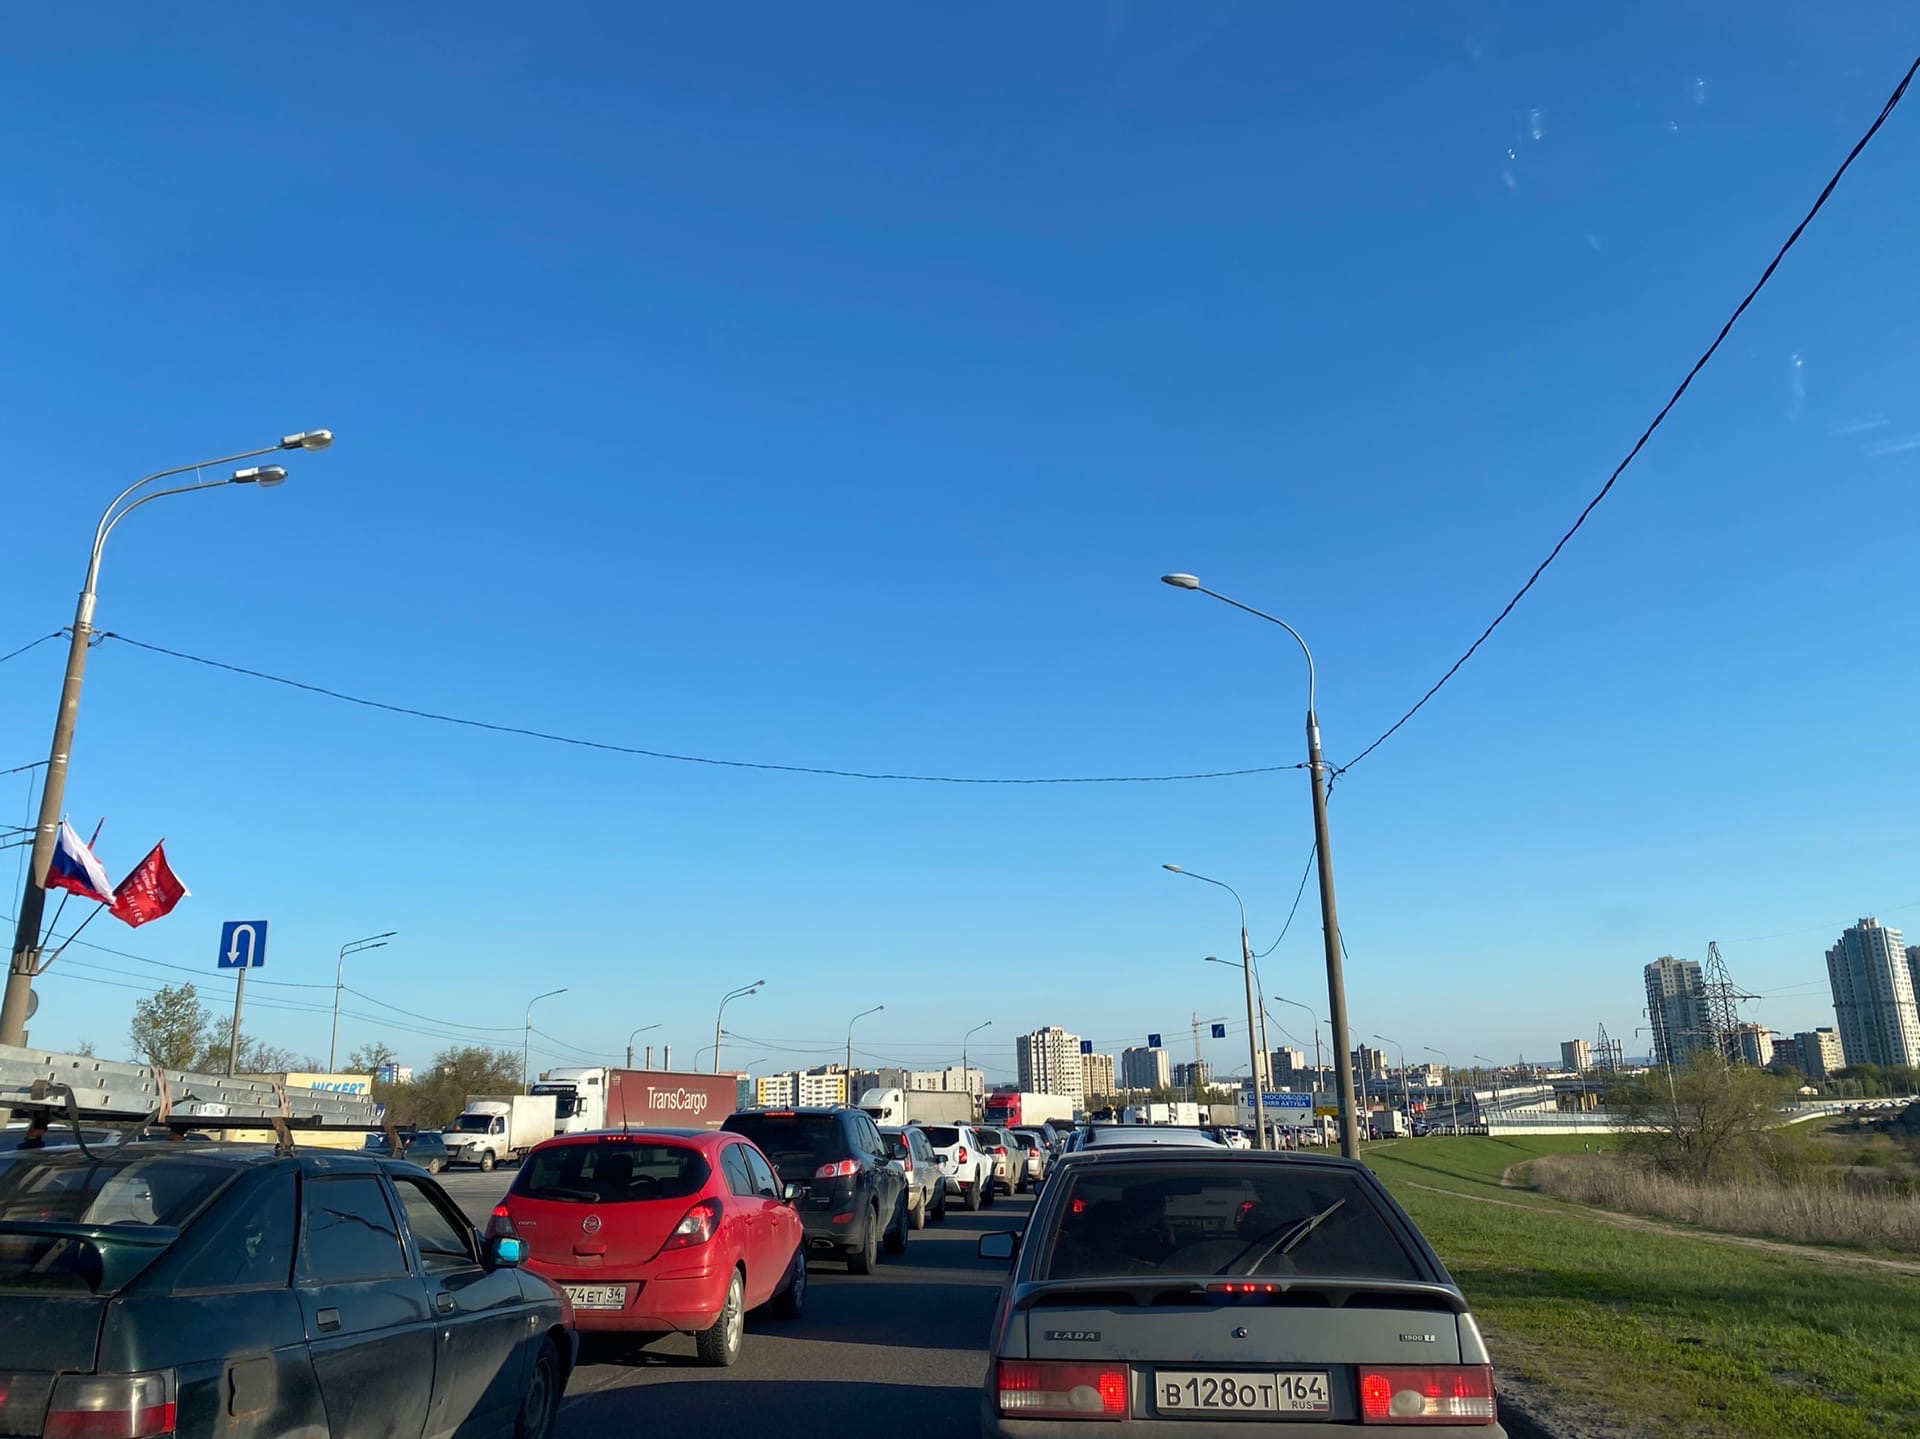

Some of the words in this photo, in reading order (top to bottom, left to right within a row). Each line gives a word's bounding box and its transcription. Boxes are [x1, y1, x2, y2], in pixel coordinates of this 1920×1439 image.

[647, 1086, 707, 1115] TransCargo
[565, 1287, 603, 1303] 74ЕТ
[607, 1288, 621, 1299] 34
[1053, 1332, 1095, 1340] LADA
[1165, 1377, 1273, 1408] В128ОТ
[1280, 1376, 1323, 1400] 164
[1292, 1401, 1312, 1409] RUS
